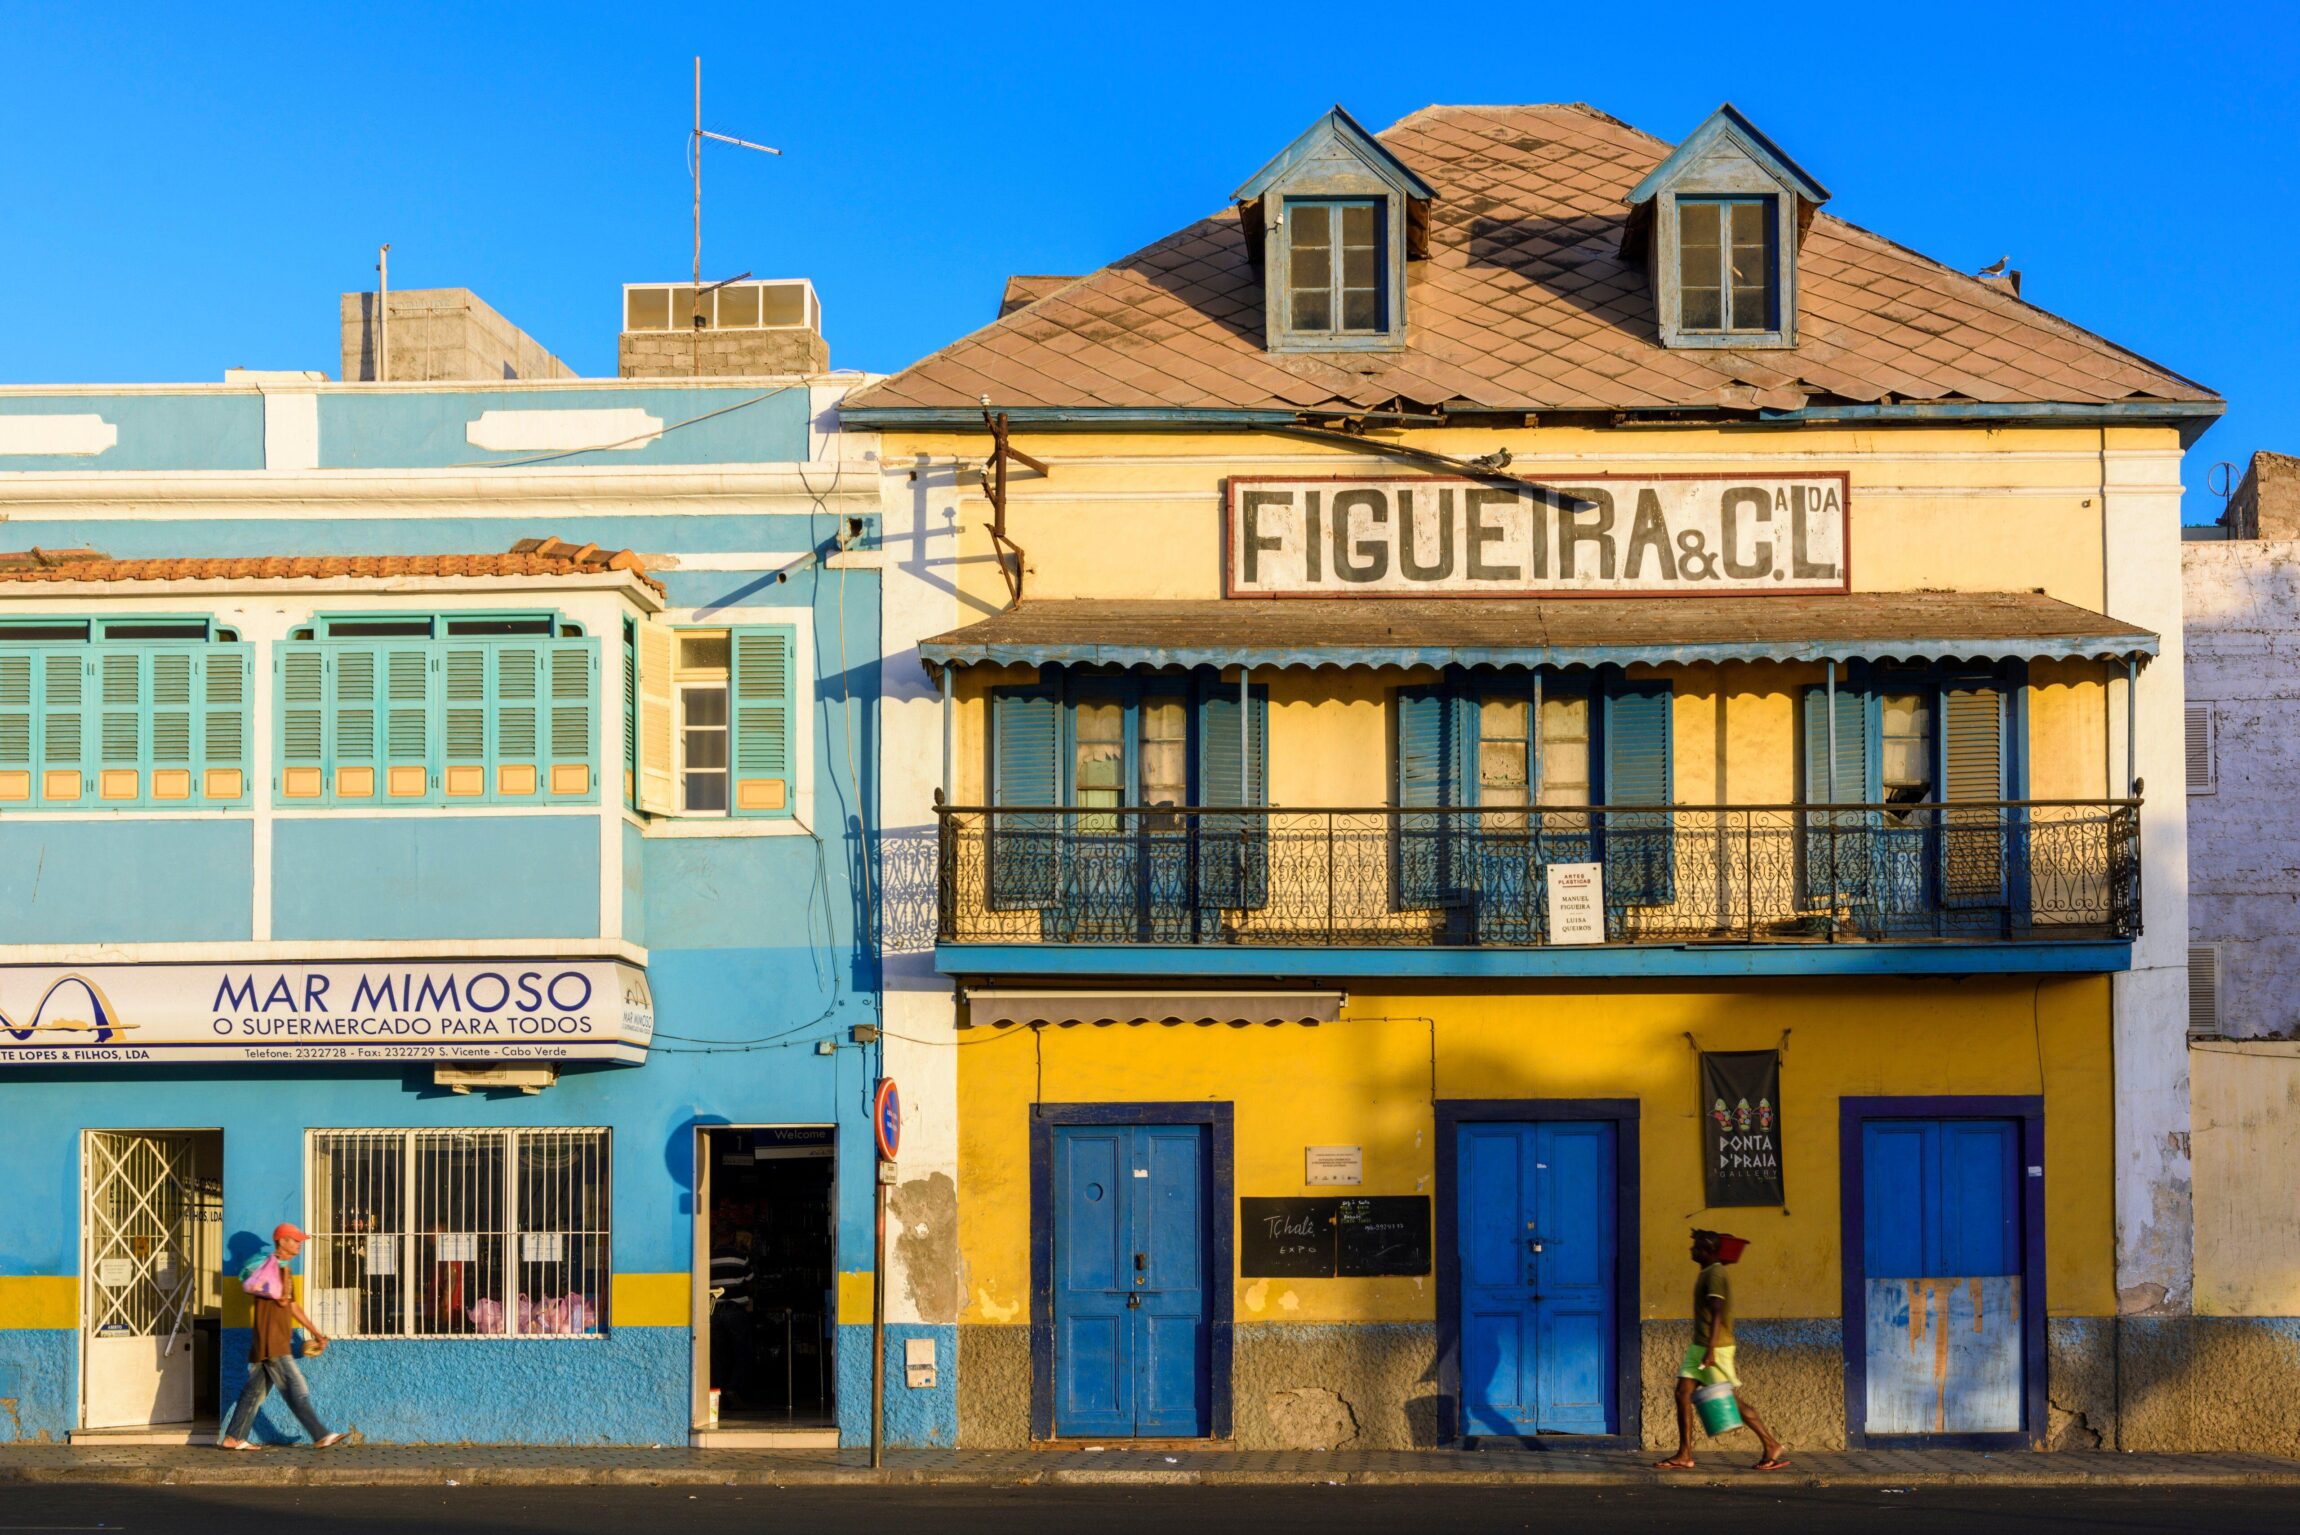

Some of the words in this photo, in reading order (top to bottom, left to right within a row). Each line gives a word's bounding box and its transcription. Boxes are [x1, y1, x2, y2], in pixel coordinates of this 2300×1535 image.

[1242, 485, 1678, 584] FIGUEIRA
[1678, 527, 1721, 582] &
[213, 974, 329, 1012] MAR
[351, 972, 591, 1012] MIMOSO
[214, 1018, 232, 1034] O
[243, 1018, 431, 1035] SUPERMERCADO
[442, 1019, 499, 1034] PARA
[507, 1016, 591, 1033] TODOS
[18, 1050, 58, 1061] LOPES
[62, 1051, 70, 1060] &
[74, 1050, 122, 1061] FILHOS,
[125, 1050, 150, 1060] LDA
[244, 1048, 292, 1058] Telefone:
[295, 1047, 347, 1058] 2322728
[358, 1047, 381, 1057] Fax:
[384, 1046, 435, 1057] 2322729
[438, 1046, 449, 1057] S.
[451, 1047, 490, 1057] Vicente
[501, 1046, 532, 1057] Cabo
[534, 1046, 567, 1057] Verde
[774, 1129, 826, 1140] Welcome
[1719, 1135, 1773, 1151] PONTA
[1720, 1154, 1777, 1169] D'PRAIA
[1719, 1169, 1777, 1177] GALLERY
[1279, 1245, 1317, 1255] EXPO
